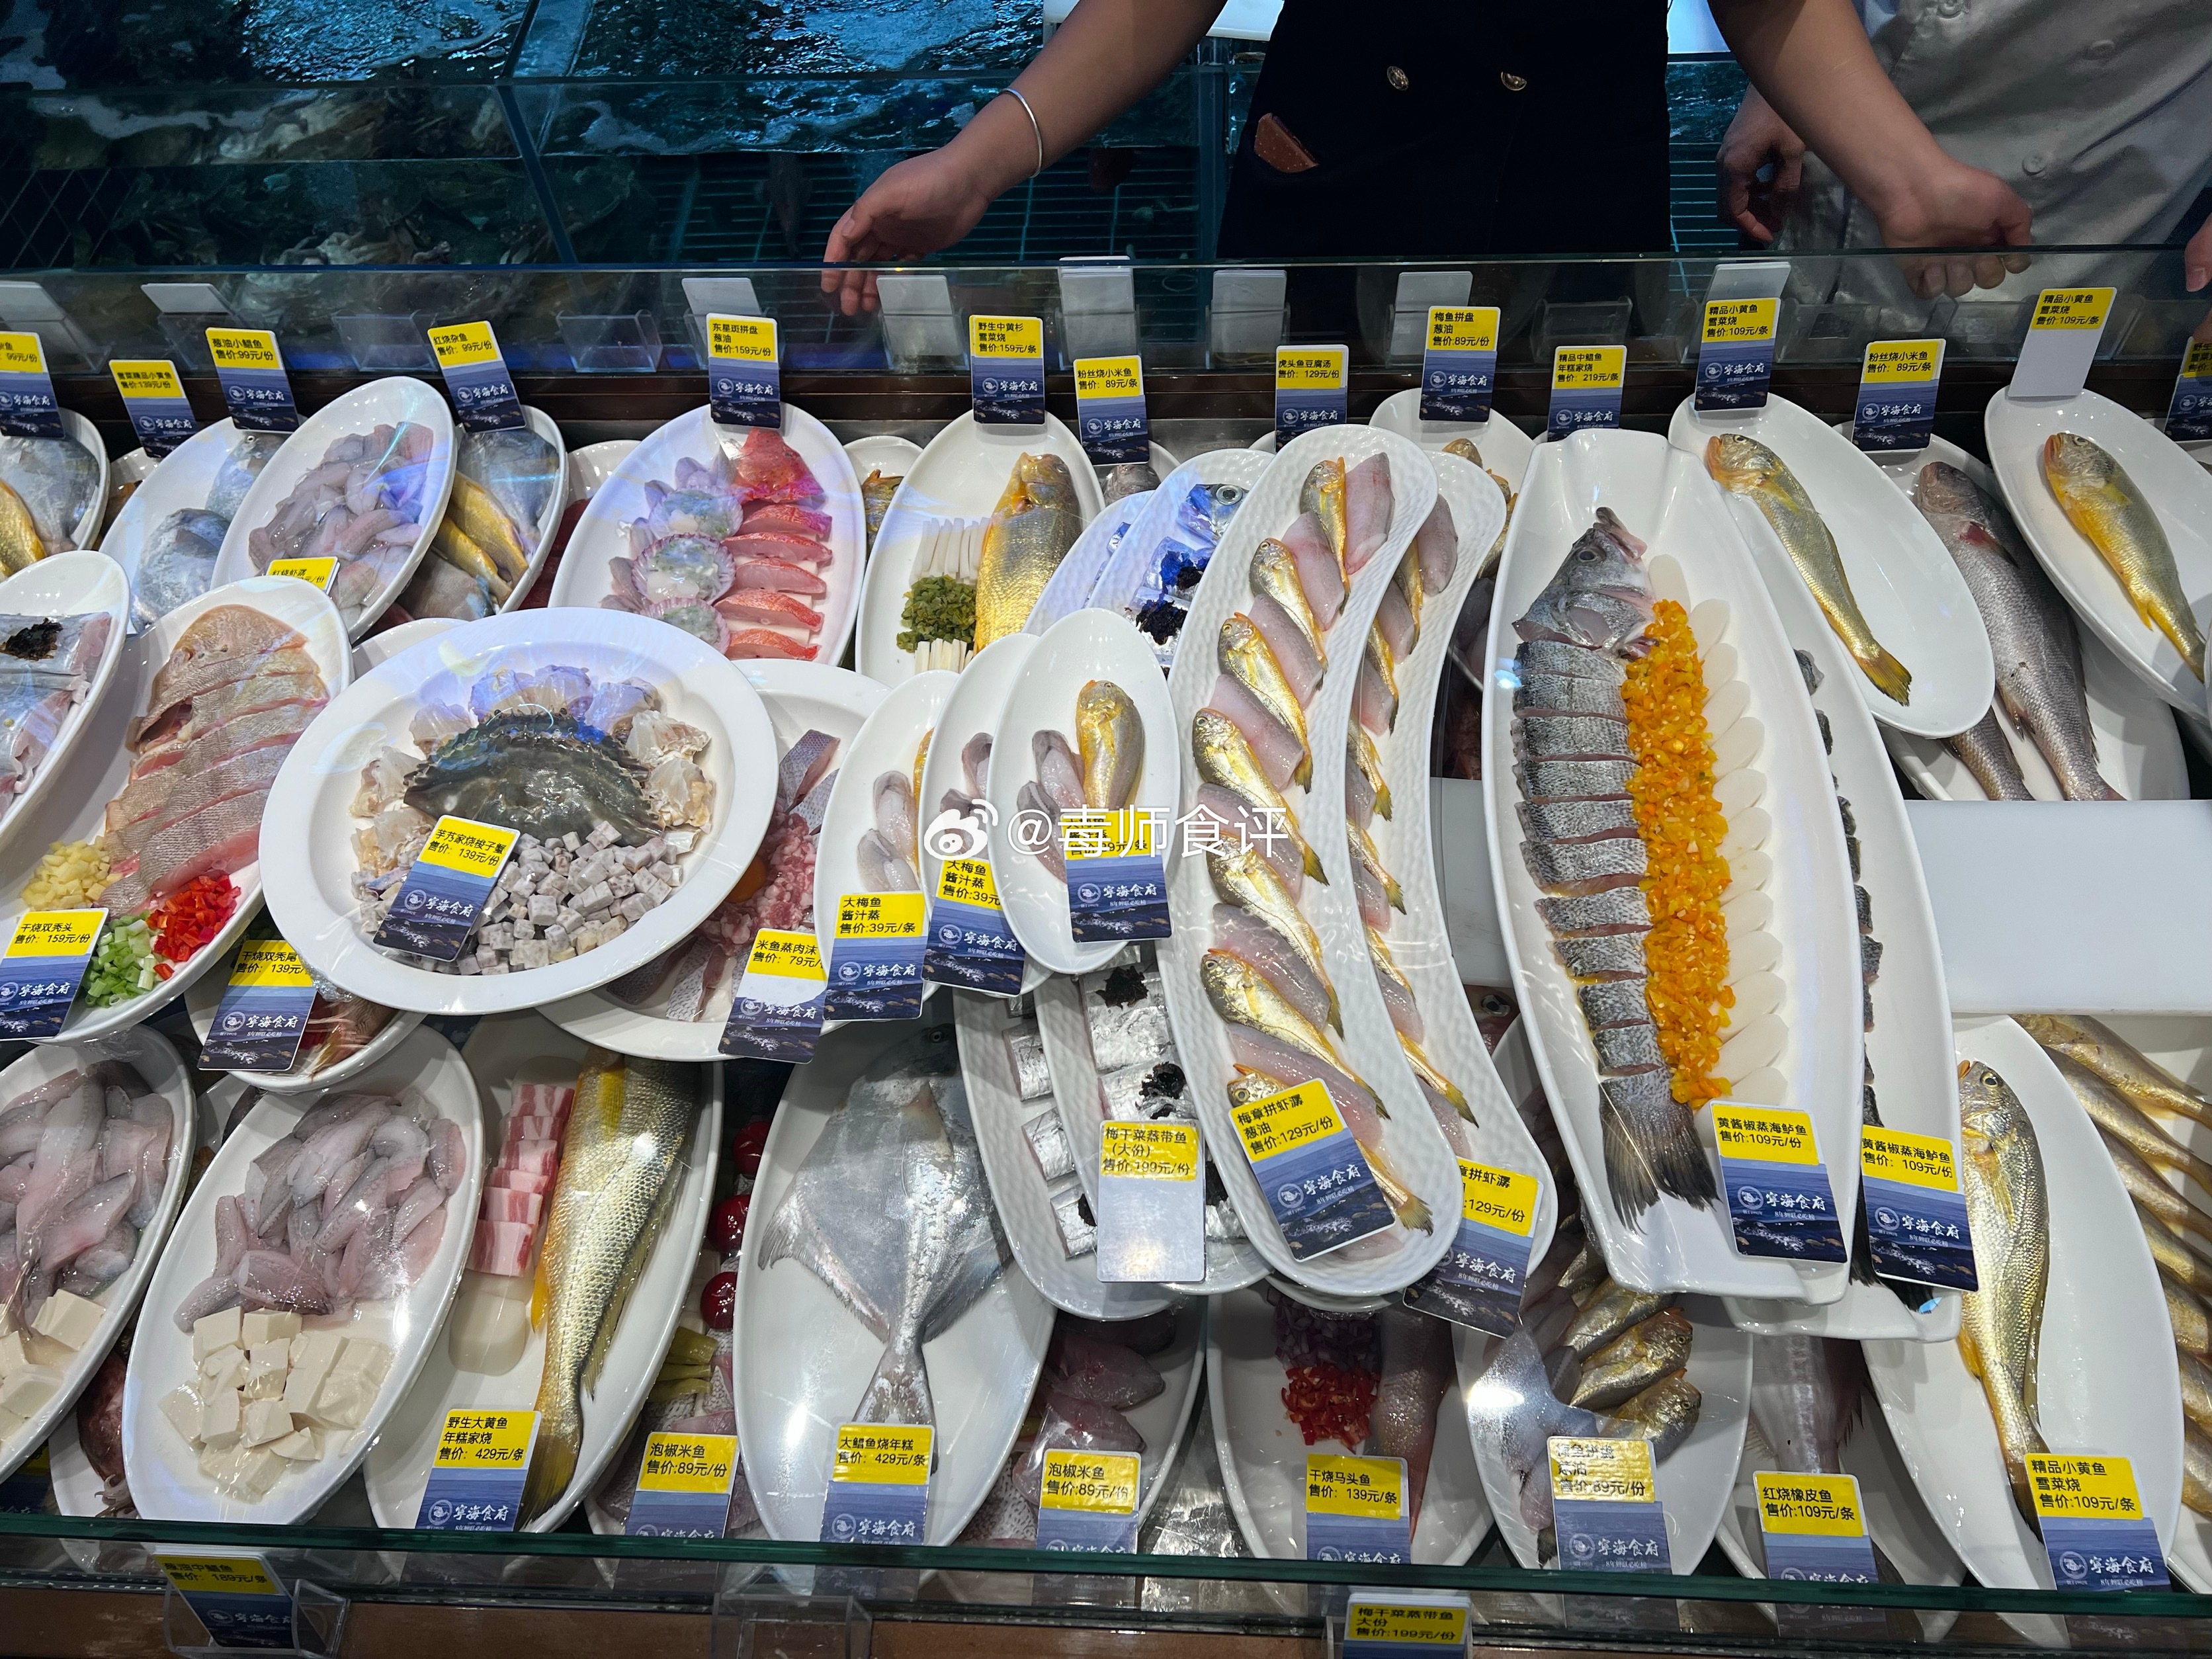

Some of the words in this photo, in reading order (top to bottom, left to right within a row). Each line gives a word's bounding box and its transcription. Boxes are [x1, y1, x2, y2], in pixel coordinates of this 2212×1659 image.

[2043, 293, 2094, 305] 精品小黄鱼
[1709, 304, 1758, 316] 精品小黄鱼
[2040, 305, 2070, 316] 雪菜烧
[1435, 312, 1474, 322] 梅鱼拼盘
[1708, 316, 1737, 327] 雪菜烧
[712, 323, 758, 335] 东星斑拼盘
[978, 322, 1023, 331] 野生中黄杉
[1433, 324, 1453, 334] 葱油
[714, 333, 732, 343] 葱油
[979, 333, 1005, 342] 雪菜烧
[1559, 353, 1602, 362] 精品中鲳鱼
[1869, 351, 1928, 362] 粉丝烧小米鱼
[1278, 359, 1331, 368] 虎头鱼豆腐汤
[1558, 364, 1593, 372] 年糕家烧
[1078, 368, 1132, 379] 粉丝烧小米鱼
[947, 860, 986, 876] 大梅鱼
[945, 872, 984, 889] 酱汁蒸
[843, 898, 881, 908] 大梅鱼
[842, 910, 880, 921] 酱汁蒸
[21, 923, 72, 933] 干烧双秃头
[839, 923, 915, 933] 售价:39元/条
[755, 940, 818, 955] 米鱼蒸肉沫
[1243, 1120, 1271, 1140] 葱油
[1717, 1117, 1807, 1136] 黄酱椒蒸海鲈鱼
[1106, 1127, 1187, 1144] 梅干菜蒸带鱼
[1719, 1130, 1802, 1148] 售价:109元/份
[1862, 1138, 1951, 1164] 黄酱椒蒸海鲈鱼
[447, 1417, 507, 1429] 野生大黄鱼
[443, 1431, 492, 1444] 年糕家烧
[840, 1437, 914, 1451] 大鲳鱼烧年糕
[650, 1443, 705, 1458] 泡椒米鱼
[647, 1460, 727, 1477] 售价:89元/份
[1048, 1463, 1105, 1480] 泡椒米鱼
[2031, 1459, 2107, 1476] 精品小黄鱼
[1309, 1469, 1371, 1486] 干烧马头鱼
[2036, 1476, 2082, 1492] 雪菜烧
[1763, 1487, 1833, 1502] 红烧橡皮鱼
[2039, 1494, 2136, 1511] 售价:109元/条
[1765, 1503, 1855, 1520] 售价:109元/条
[1359, 1607, 1453, 1621] 梅干菜蒸带鱼
[1357, 1619, 1388, 1627] 大份
